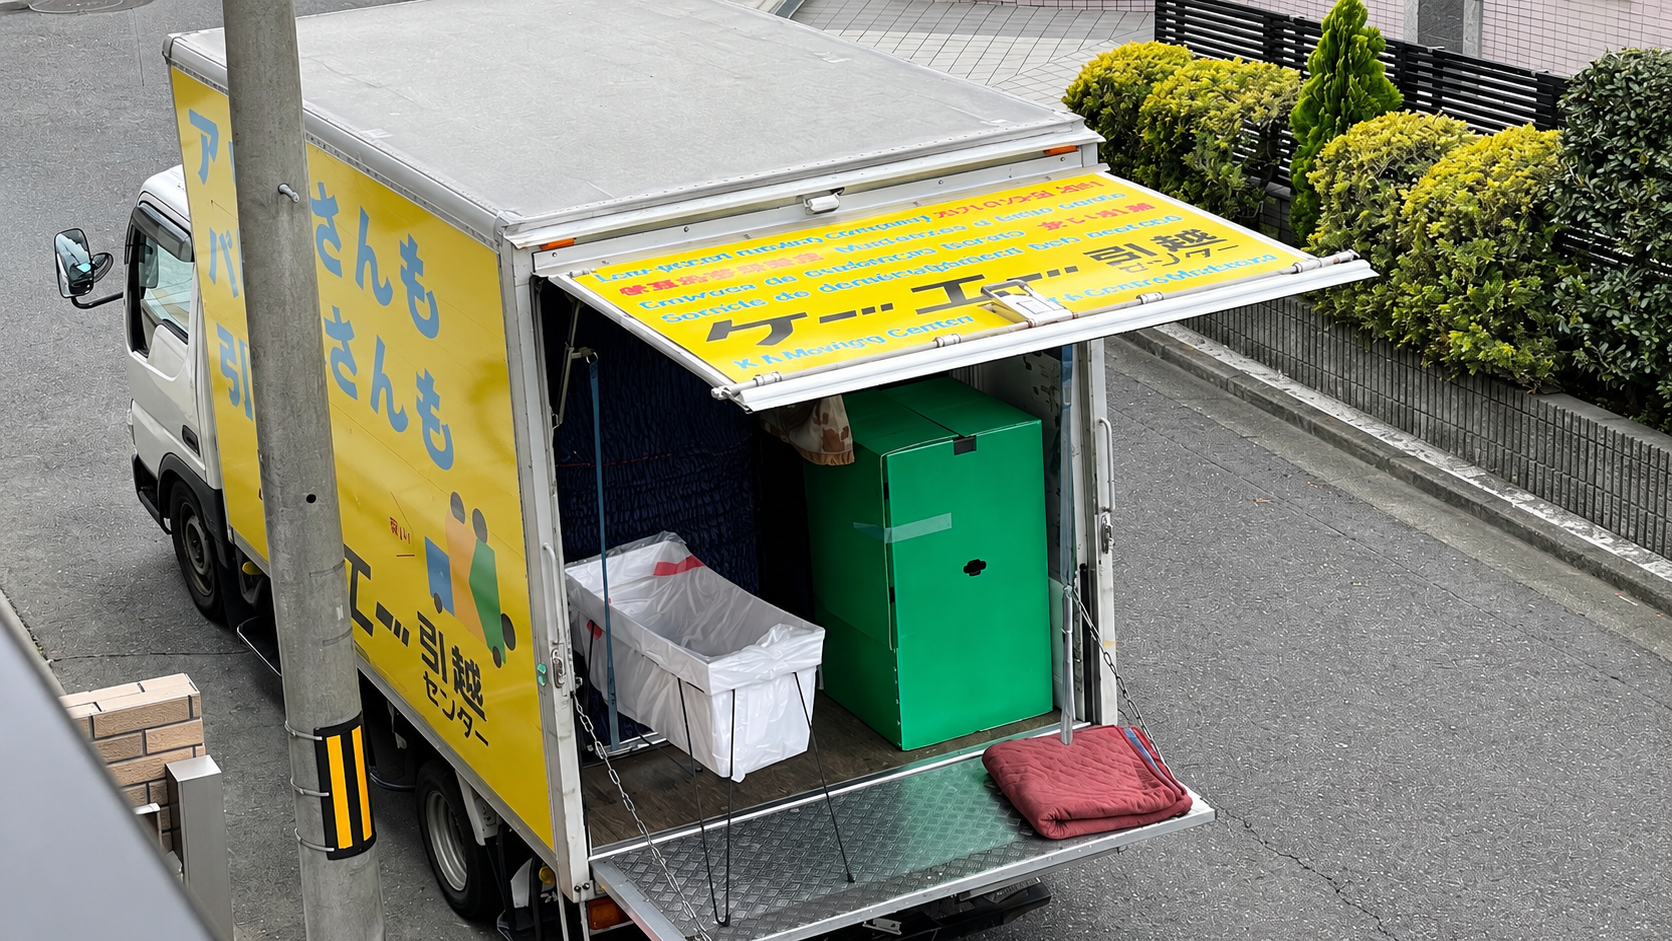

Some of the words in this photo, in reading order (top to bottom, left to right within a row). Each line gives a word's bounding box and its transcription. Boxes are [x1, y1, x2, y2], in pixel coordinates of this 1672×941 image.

[1083, 229, 1227, 266] 引越
[417, 610, 488, 722] 引越
[422, 670, 490, 748] センター
